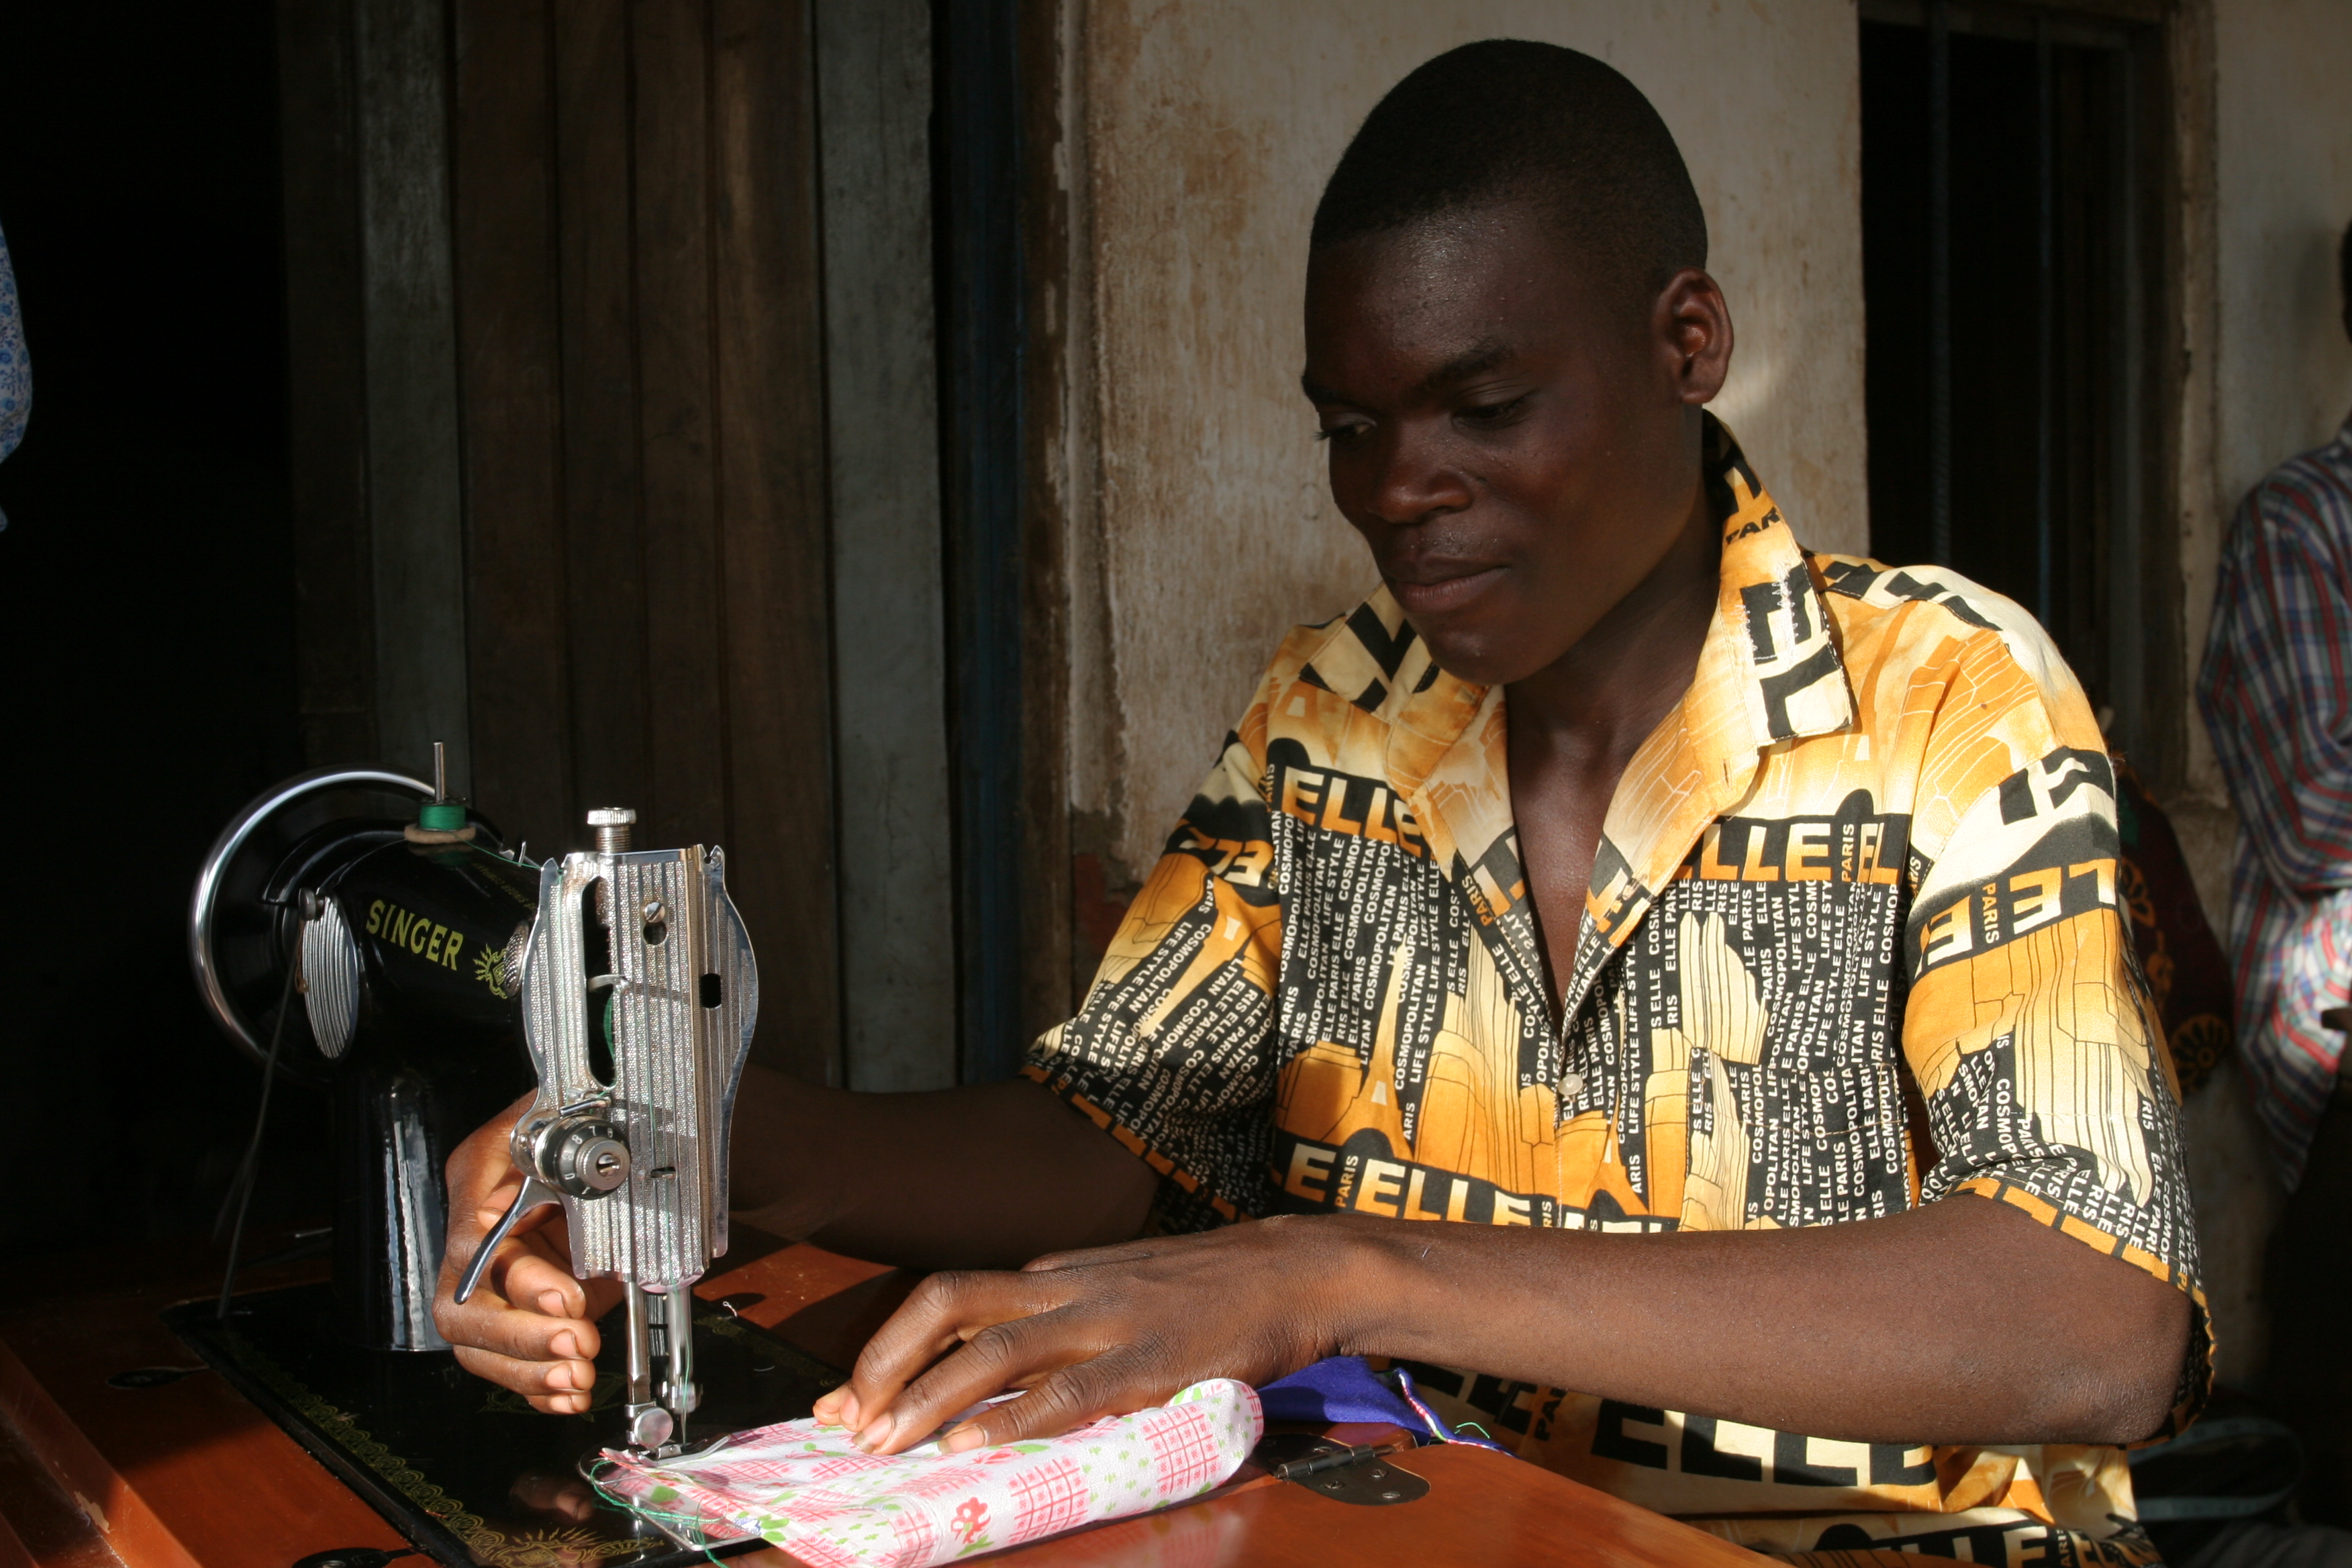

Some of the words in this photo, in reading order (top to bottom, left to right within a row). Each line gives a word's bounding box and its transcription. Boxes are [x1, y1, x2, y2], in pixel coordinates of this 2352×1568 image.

[1281, 766, 1422, 859] ELLE
[1305, 830, 1317, 869] ELLE
[1326, 838, 1346, 889] STYLE
[1338, 834, 1363, 901] COSMOP
[1674, 823, 1832, 881] LLE
[1841, 823, 1855, 883] PARIS
[1304, 871, 1314, 916] PARIS
[1343, 838, 1377, 961] COSMOPOLITAN
[1391, 895, 1410, 942] PARIS
[1402, 854, 1410, 893] ELLE
[1416, 863, 1426, 913] STYLE
[1428, 860, 1441, 898] ELLE
[1679, 879, 1691, 910] LLE
[1692, 880, 1704, 911] RIS
[1705, 880, 1718, 912] LLE
[1717, 883, 1729, 913] RIS
[1279, 858, 1302, 983] COSMOPOLITAN
[1308, 857, 1326, 979] COSMOPOLITAN
[1323, 891, 1334, 926] LIFE
[1728, 882, 1740, 926] ELLE
[1742, 888, 1754, 941] PARIS
[1755, 881, 1769, 924] ELLE
[1982, 883, 2000, 944] PARIS
[365, 898, 464, 972] SINGER
[1165, 921, 1193, 948] LIFE
[1297, 919, 1311, 959] ELLE
[1331, 912, 1345, 952] ELLE
[1419, 914, 1430, 948] LIFE
[1430, 904, 1441, 952] STYLE
[1820, 919, 1831, 959] LIFE
[1857, 956, 1873, 998] LIFE
[1865, 891, 1882, 952] STYLE
[1879, 883, 1900, 965] COSMOP
[1128, 923, 1212, 1014] COSMOPOLITAN
[1131, 947, 1169, 986] STYLE
[1363, 884, 1398, 1011] COSMOPOLITAN
[1447, 939, 1459, 979] ELLE
[1491, 943, 1522, 984] ELLE
[1576, 935, 1602, 974] ELLE
[1626, 934, 1636, 991] STYLE
[1665, 928, 1677, 972] ELLE
[1743, 946, 1757, 968] LE
[1766, 896, 1787, 1038] COSMOPOLITAN
[1792, 932, 1802, 971] LIFE
[1208, 957, 1243, 996] LITAN
[1305, 942, 1329, 1045] SMOPOLITAN
[1328, 952, 1341, 1000] PARIS
[1340, 971, 1351, 1010] ELLE
[1351, 956, 1367, 1003] PARIS
[1428, 955, 1441, 991] LIFE
[1458, 967, 1467, 995] RIS
[1649, 969, 1662, 1012] ELLE
[1760, 948, 1773, 1001] PARIS
[1814, 1018, 1833, 1058] LIFE
[1824, 954, 1842, 1014] STYLE
[1834, 904, 1845, 950] ELLE
[1107, 985, 1136, 1012] LIFE
[1214, 979, 1246, 1013] ELLE
[1234, 988, 1259, 1014] RIS
[1243, 993, 1271, 1028] ELLE
[1278, 985, 1300, 1034] PARIS
[1628, 995, 1638, 1033] LIFE
[1666, 995, 1679, 1024] RIS
[1785, 1000, 1806, 1052] PARIS
[1799, 952, 1818, 996] ELLE
[1873, 979, 1890, 1026] ELLE
[1087, 1012, 1113, 1064] STYLE
[1104, 1020, 1127, 1055] LIFE
[1182, 1010, 1219, 1049] PARIS
[1206, 1011, 1239, 1045] ELLE
[1285, 1012, 1308, 1059] PARIS
[1321, 1003, 1337, 1043] ELLE
[1336, 1014, 1349, 1040] RIS
[1347, 1006, 1360, 1044] ELLE
[1393, 964, 1427, 1091] COSMOPOLITAN
[1418, 993, 1438, 1044] STYLE
[1210, 1026, 1246, 1064] PARIS
[1360, 1020, 1372, 1066] LITAN
[1584, 1016, 1600, 1065] PARIS
[1186, 1062, 1214, 1095] ELLE
[1409, 1048, 1426, 1083] LIFE
[1630, 1037, 1641, 1089] STYLE
[1729, 1065, 1738, 1089] LE
[1969, 1055, 1988, 1090] LLE
[1102, 1077, 1132, 1111] ELLE
[1591, 1065, 1605, 1107] ELLE
[1692, 1071, 1703, 1115] ELLE
[1740, 1071, 1752, 1124] PARIS
[1781, 1077, 1792, 1123] ELLE
[588, 1125, 597, 1136] 7
[1628, 1097, 1640, 1134] LIFE
[1704, 1102, 1713, 1132] RIS
[1751, 1064, 1765, 1164] COSMOPOL
[1799, 1080, 1812, 1140] STYLE
[1808, 1072, 1828, 1151] COSMOP
[2141, 1099, 2155, 1132] RIS
[571, 1134, 583, 1145] 8
[1780, 1128, 1792, 1182] PARIS
[1864, 1114, 1881, 1160] ELLE
[2017, 1118, 2045, 1160] PARIS
[1628, 1155, 1643, 1193] ARIS
[1763, 1118, 1779, 1212] OPOLITAN
[1788, 1106, 1801, 1227] SMOPOLITAN
[1802, 1144, 1812, 1185] LIFE
[1833, 1141, 1849, 1195] PARIS
[2151, 1151, 2163, 1202] ELLE
[1333, 1155, 1359, 1208] PARIS
[1354, 1158, 1532, 1226] ELLE
[1776, 1187, 1790, 1221] LLE
[1818, 1165, 1833, 1211] ELLE
[1871, 1189, 1886, 1219] RIS
[2063, 1169, 2092, 1215] ELLE
[2082, 1183, 2105, 1221] RIS
[1838, 1199, 1850, 1222] LE
[2097, 1193, 2122, 1234] LLE
[2114, 1202, 2137, 1238] RIS
[2128, 1210, 2149, 1250] LLE
[2159, 1180, 2173, 1265] COSMOP
